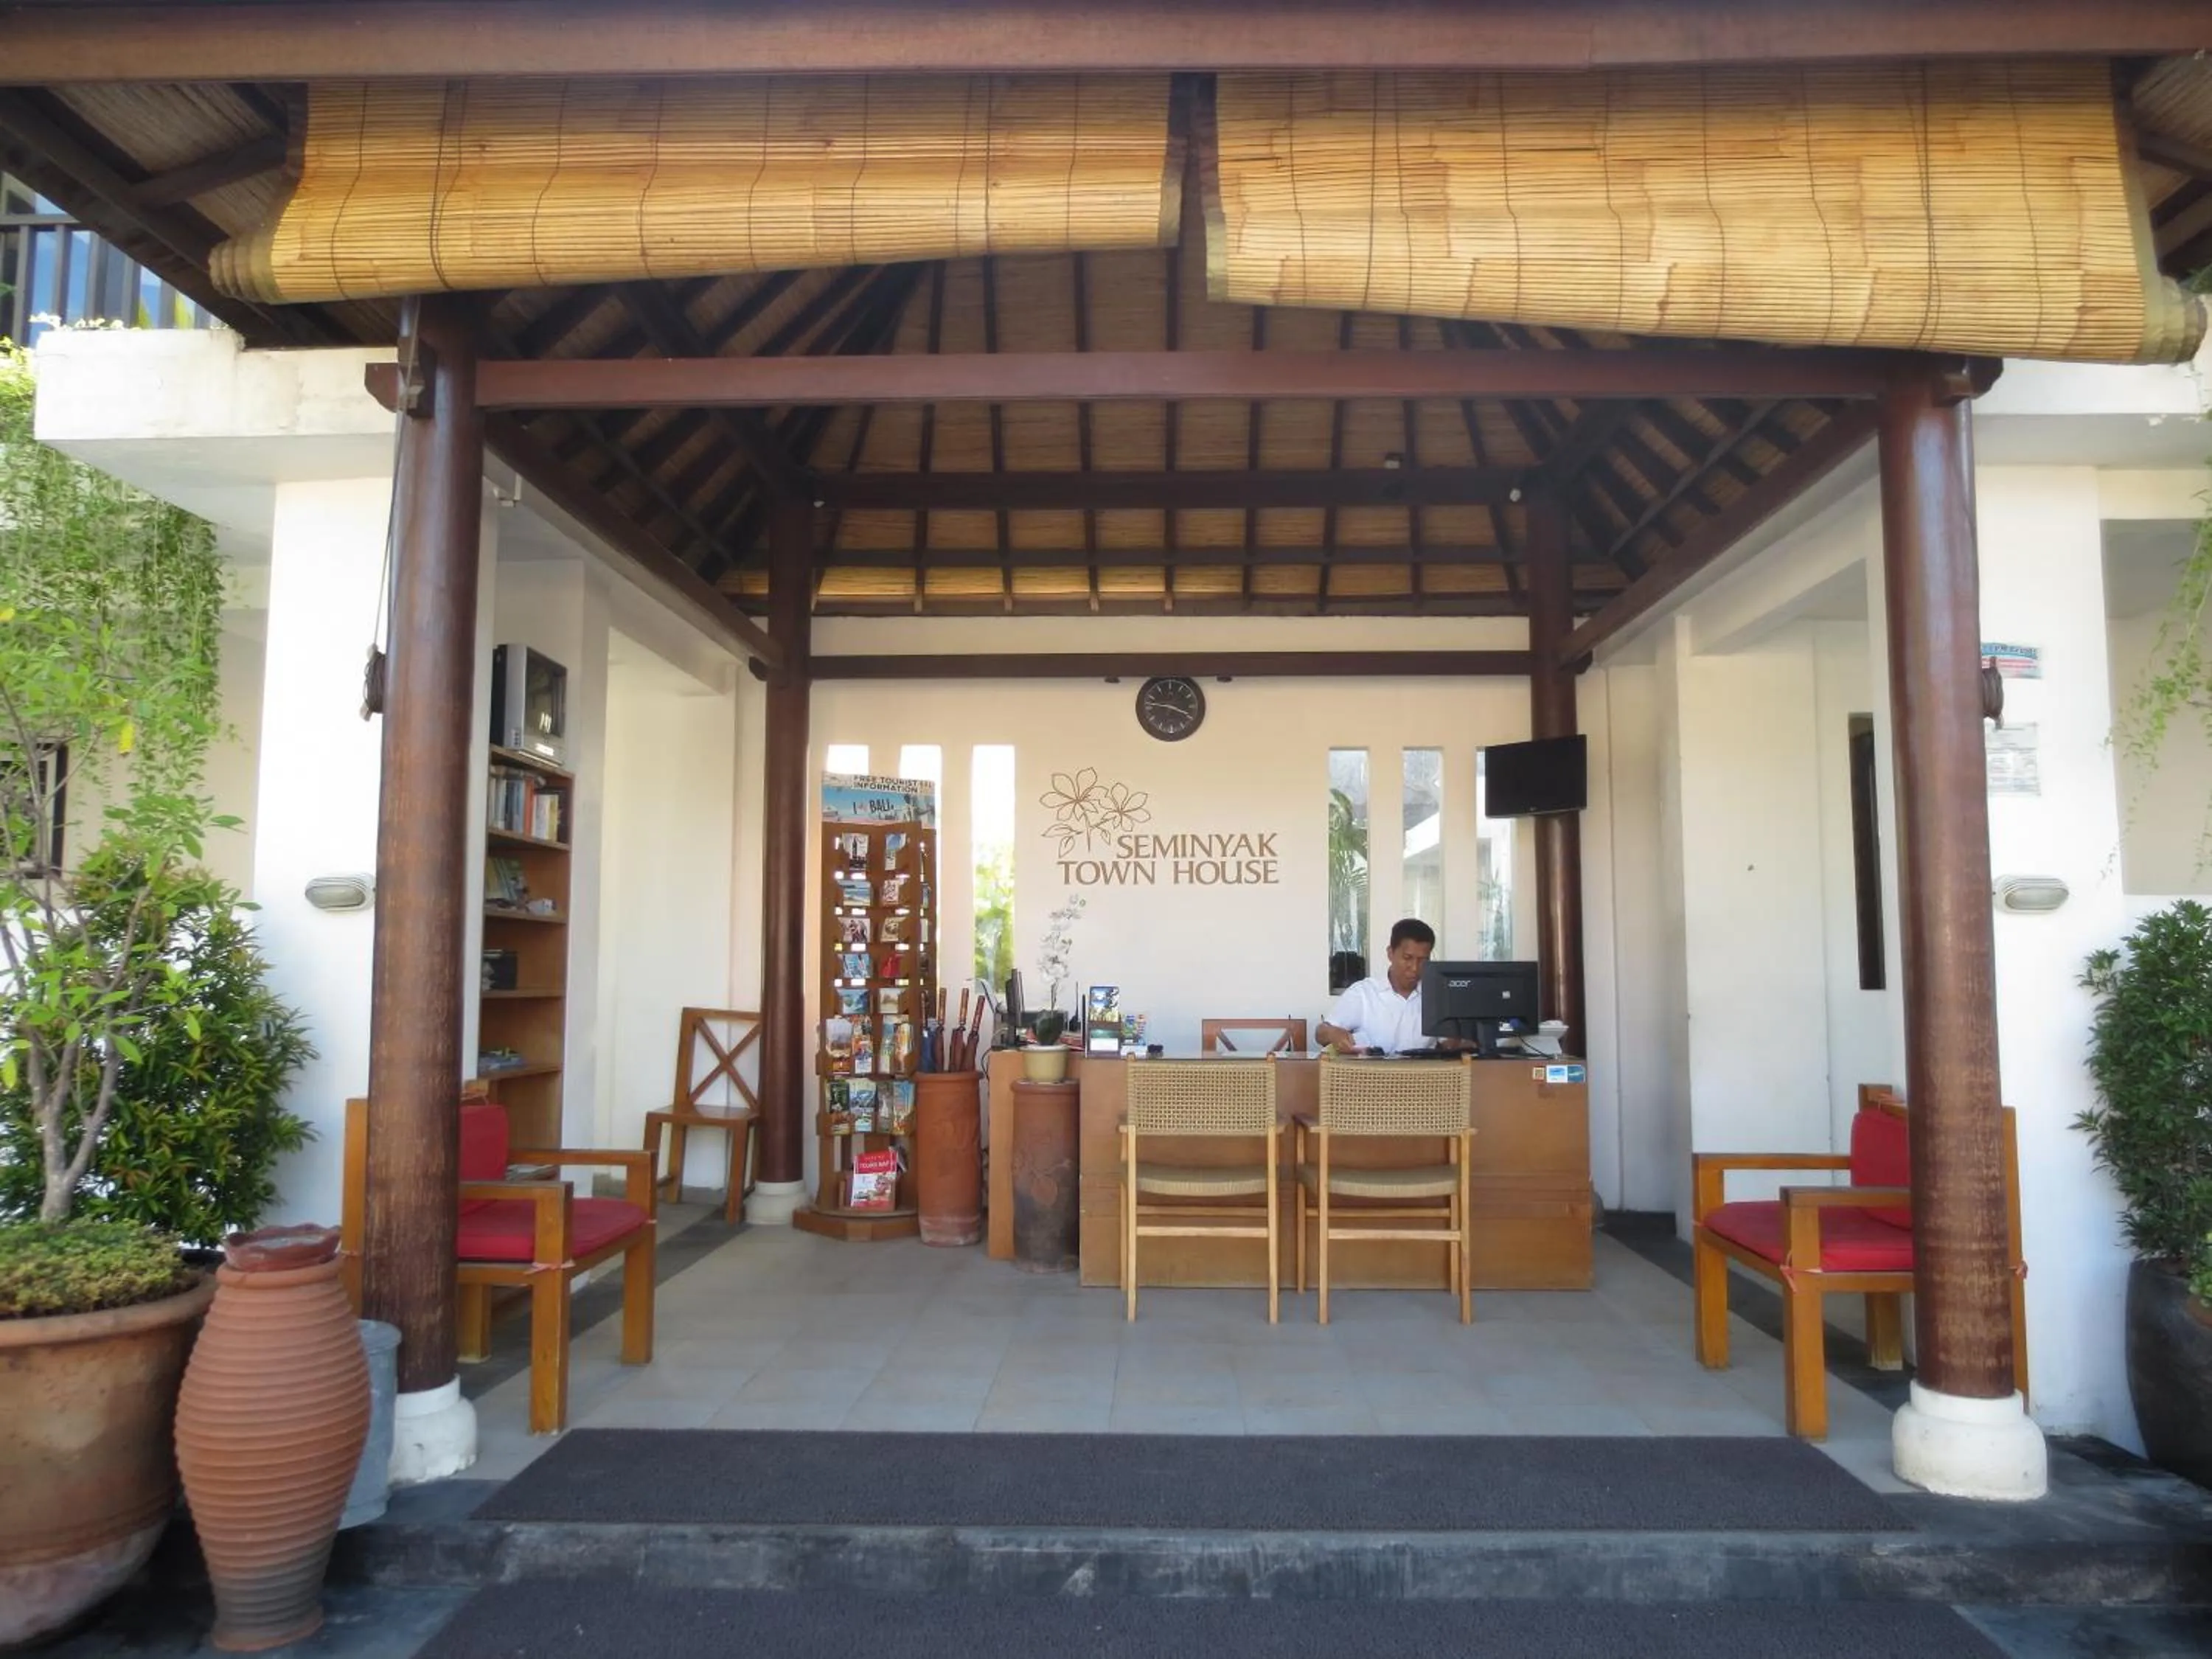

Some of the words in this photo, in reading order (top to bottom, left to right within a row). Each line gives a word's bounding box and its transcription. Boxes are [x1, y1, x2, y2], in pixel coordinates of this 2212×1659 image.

[852, 781, 918, 793] INFORMATION
[880, 776, 917, 787] TOURIST
[1116, 832, 1278, 858] SEMINYAK
[1057, 860, 1155, 885] TOWN
[1173, 860, 1279, 885] HOUSE
[1447, 980, 1472, 988] acer
